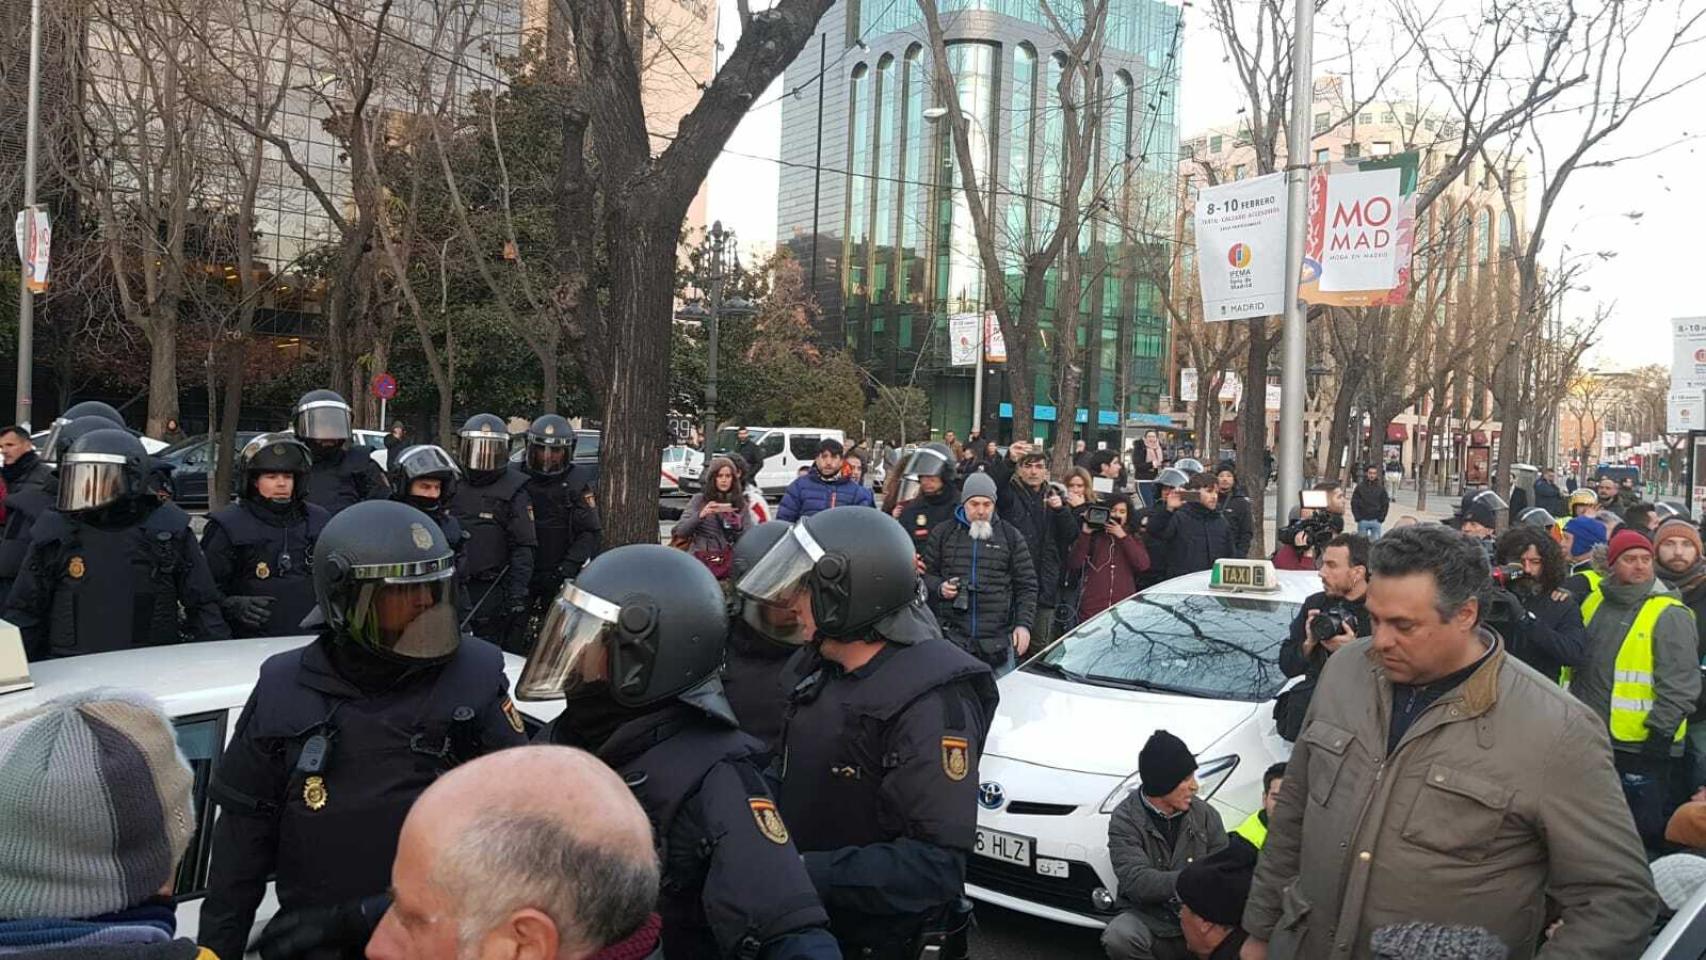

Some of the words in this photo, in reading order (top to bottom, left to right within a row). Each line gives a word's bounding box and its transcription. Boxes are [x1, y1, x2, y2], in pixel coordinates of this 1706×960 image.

[1241, 195, 1275, 210] FEBRERO
[1332, 196, 1391, 229] MO
[1330, 229, 1390, 251] MAD
[1230, 302, 1265, 312] MADRID
[1224, 567, 1250, 583] TAXI
[992, 835, 1024, 861] HLZ
